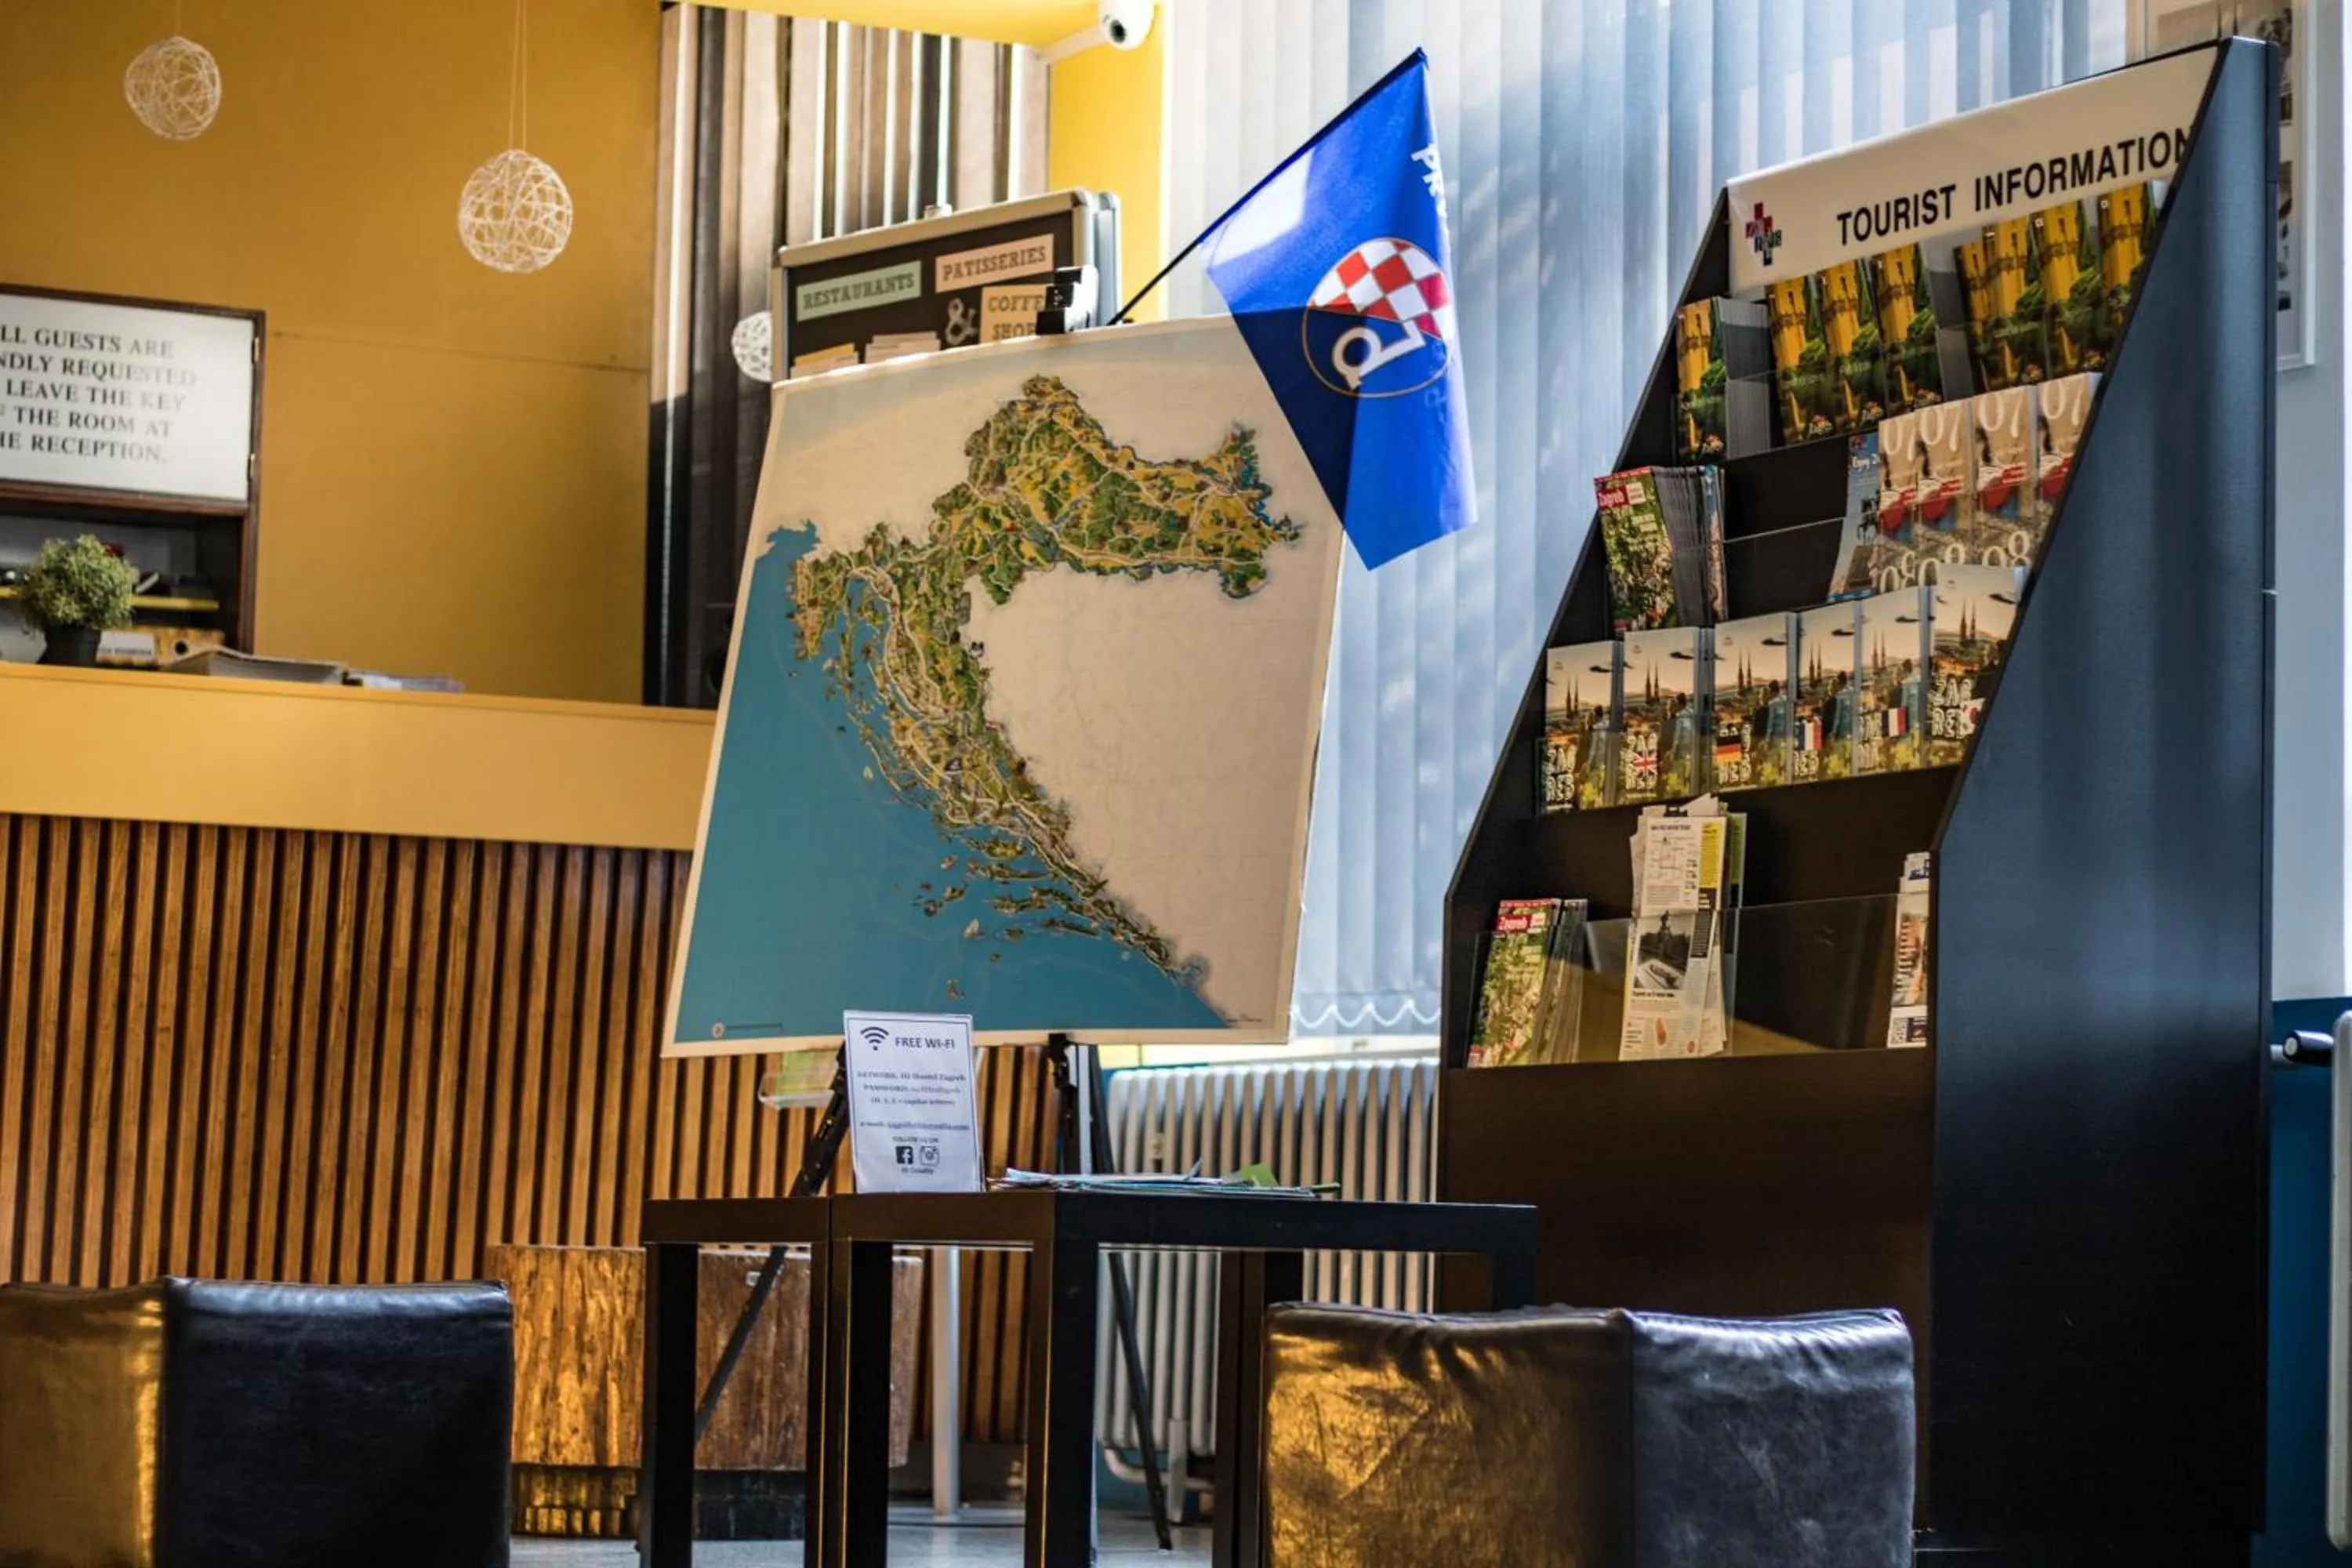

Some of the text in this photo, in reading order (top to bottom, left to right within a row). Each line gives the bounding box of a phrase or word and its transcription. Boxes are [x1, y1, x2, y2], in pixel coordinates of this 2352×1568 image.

[1837, 124, 2194, 246] TOURIST INFORMATION
[942, 245, 1047, 282] PATISSERIES
[803, 273, 915, 310] RESTAURANTS
[945, 294, 1043, 346] & COFFE
[0, 325, 174, 358] LL GUESTS ARE
[62, 358, 196, 386] REQUESTED
[7, 379, 187, 412] LEAVE THE KEY
[14, 406, 60, 427] THE
[69, 412, 135, 432] ROOM
[145, 419, 173, 437] AT
[31, 434, 166, 463] RECEPTION.
[895, 1037, 955, 1049] FREE WI-FI
